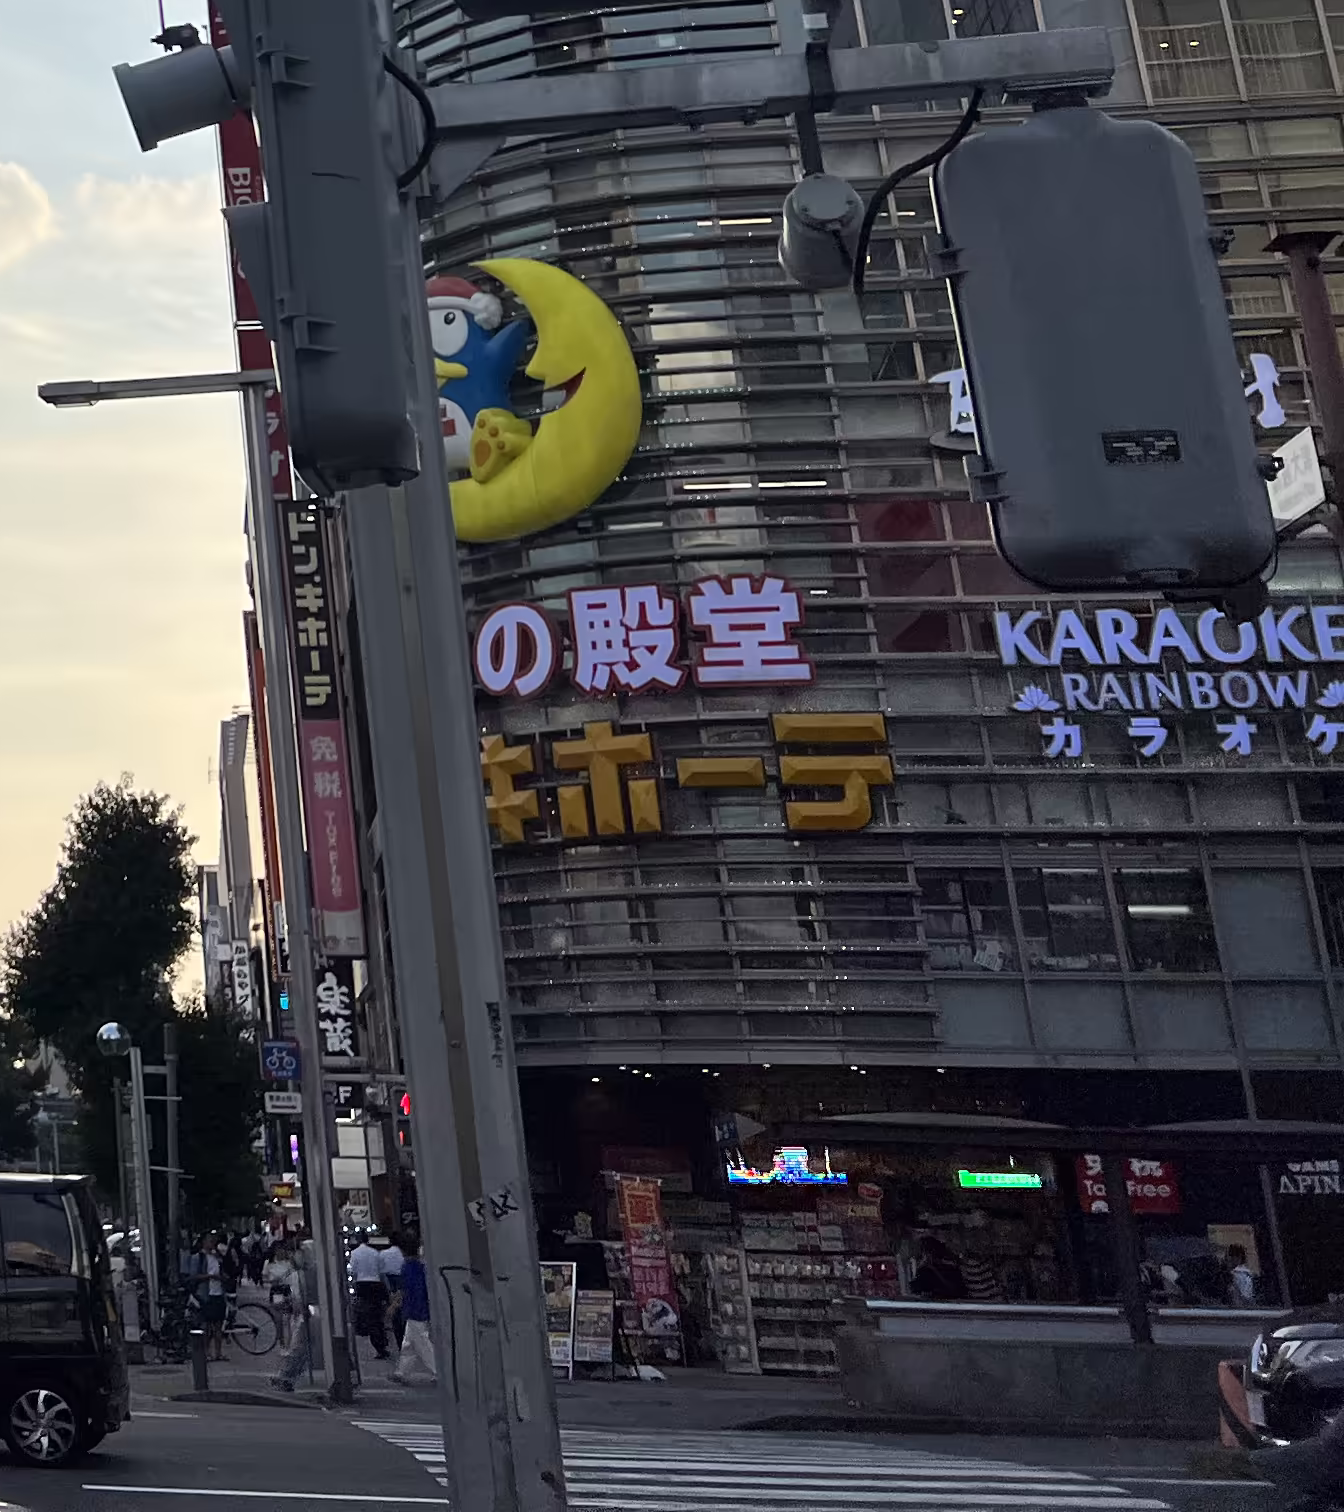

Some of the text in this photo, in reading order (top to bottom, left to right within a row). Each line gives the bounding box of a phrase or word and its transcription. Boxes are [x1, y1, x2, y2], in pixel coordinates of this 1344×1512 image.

[476, 576, 814, 699] の殿堂
[994, 603, 1344, 666] KARAOKE
[1062, 670, 1310, 711] RAINBOW
[1042, 715, 1344, 758] カラオケ
